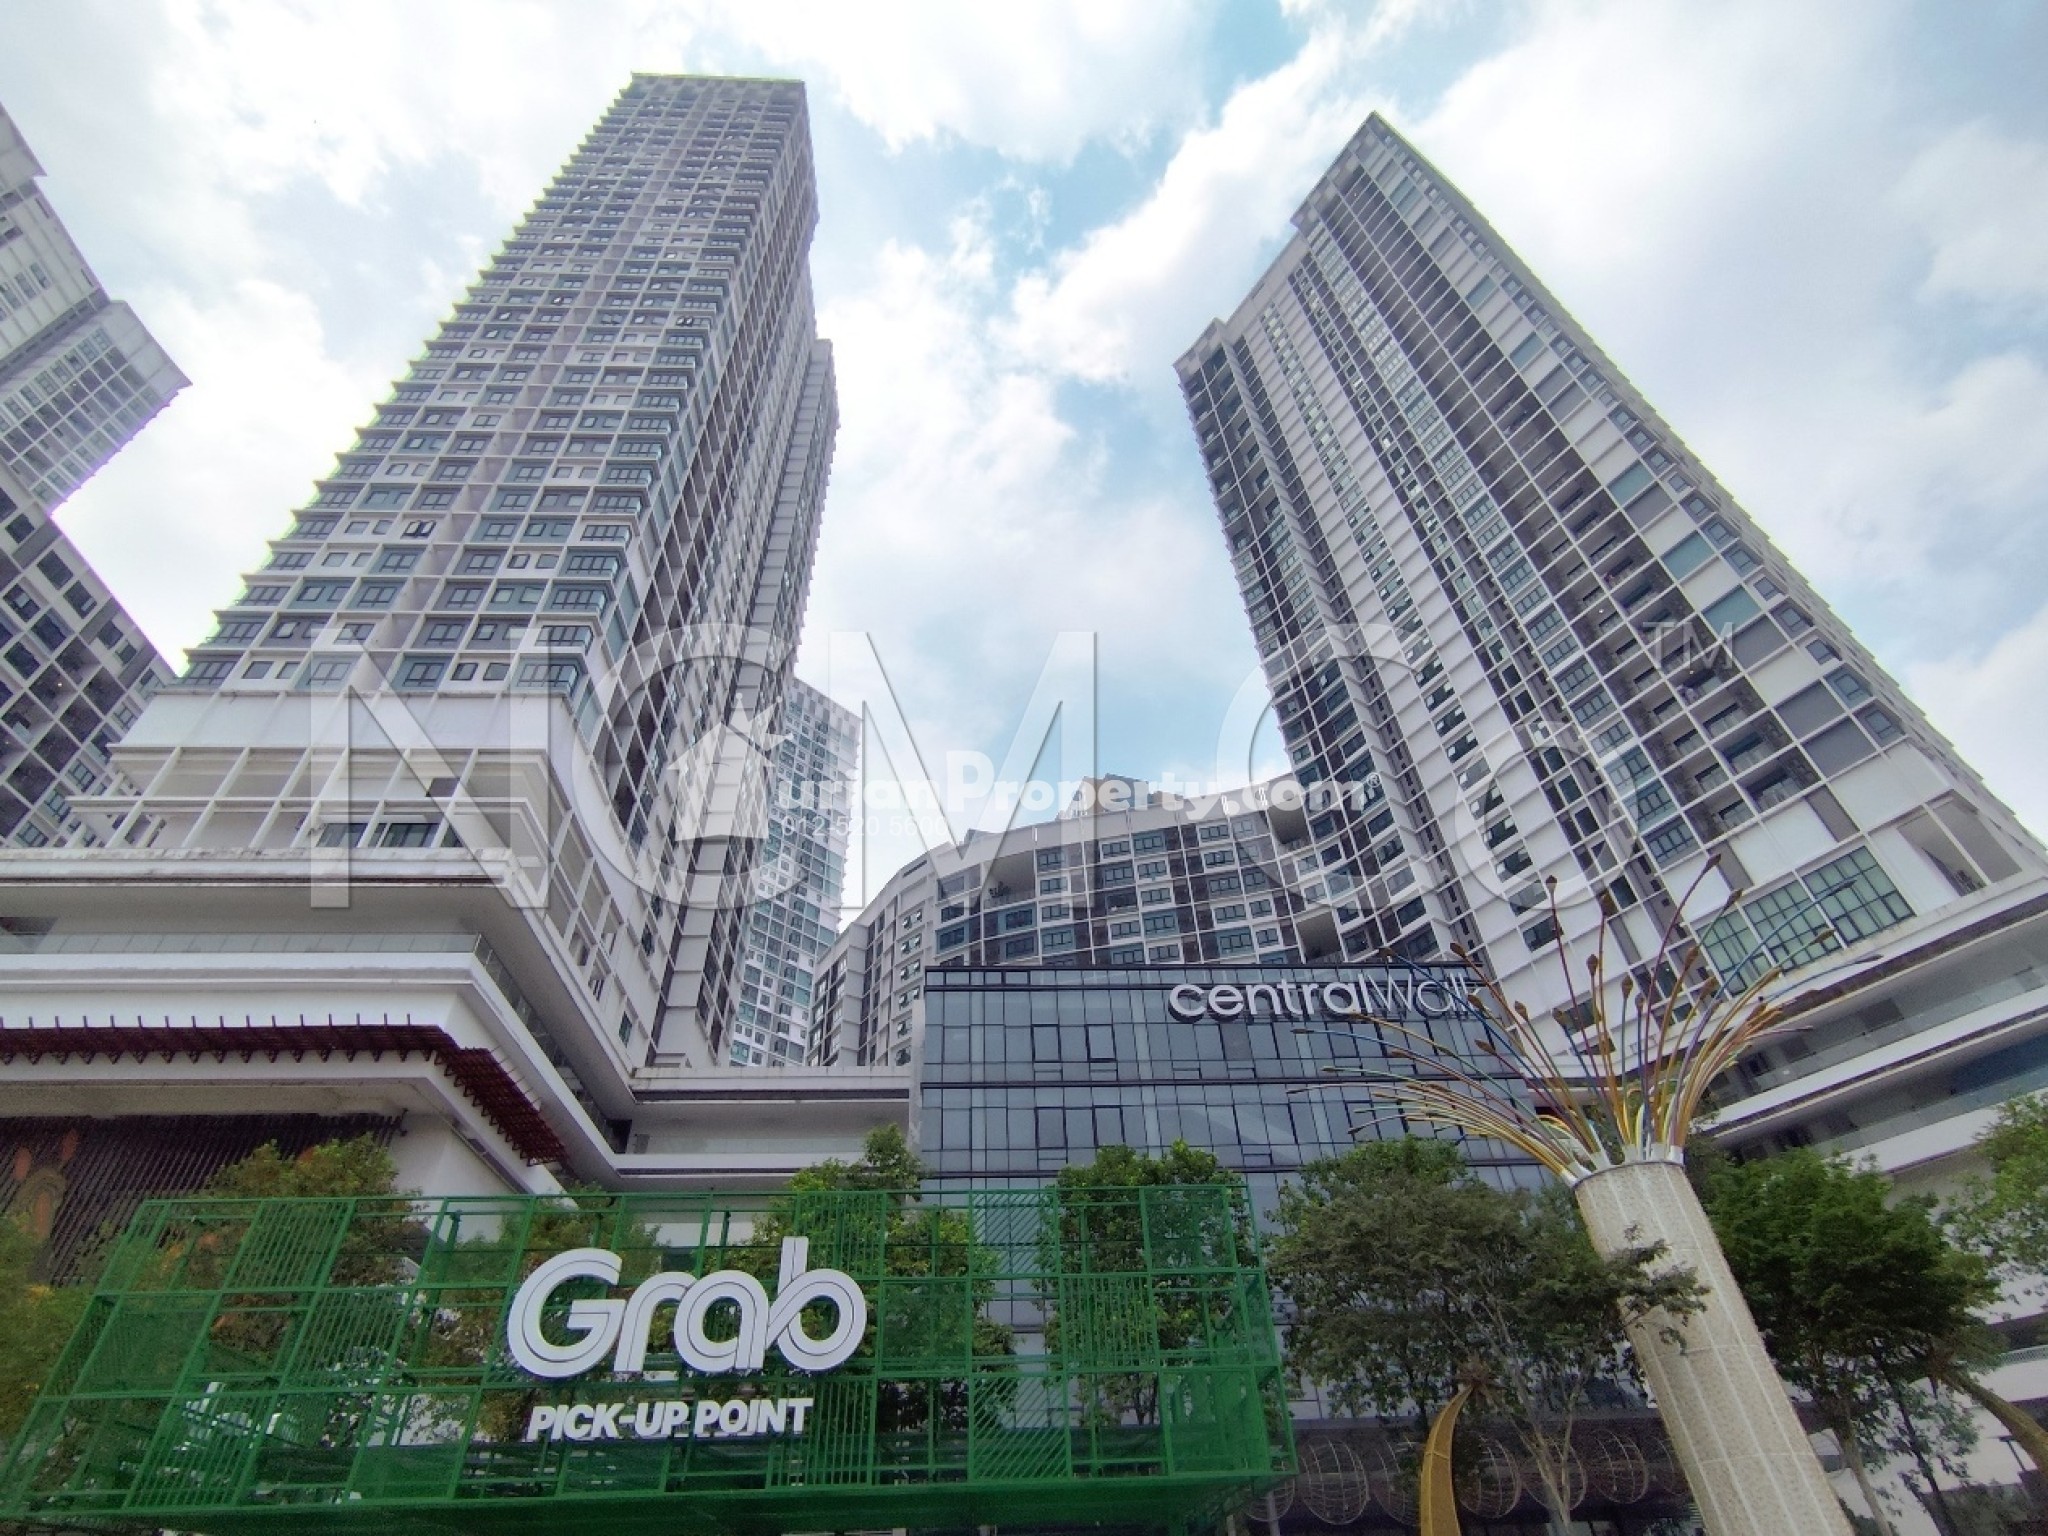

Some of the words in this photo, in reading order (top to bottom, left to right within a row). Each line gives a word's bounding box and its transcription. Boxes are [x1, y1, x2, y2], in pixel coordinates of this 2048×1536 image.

[507, 1236, 868, 1378] Grab
[526, 1401, 690, 1442] PICK-UP
[695, 1397, 815, 1438] POINT
